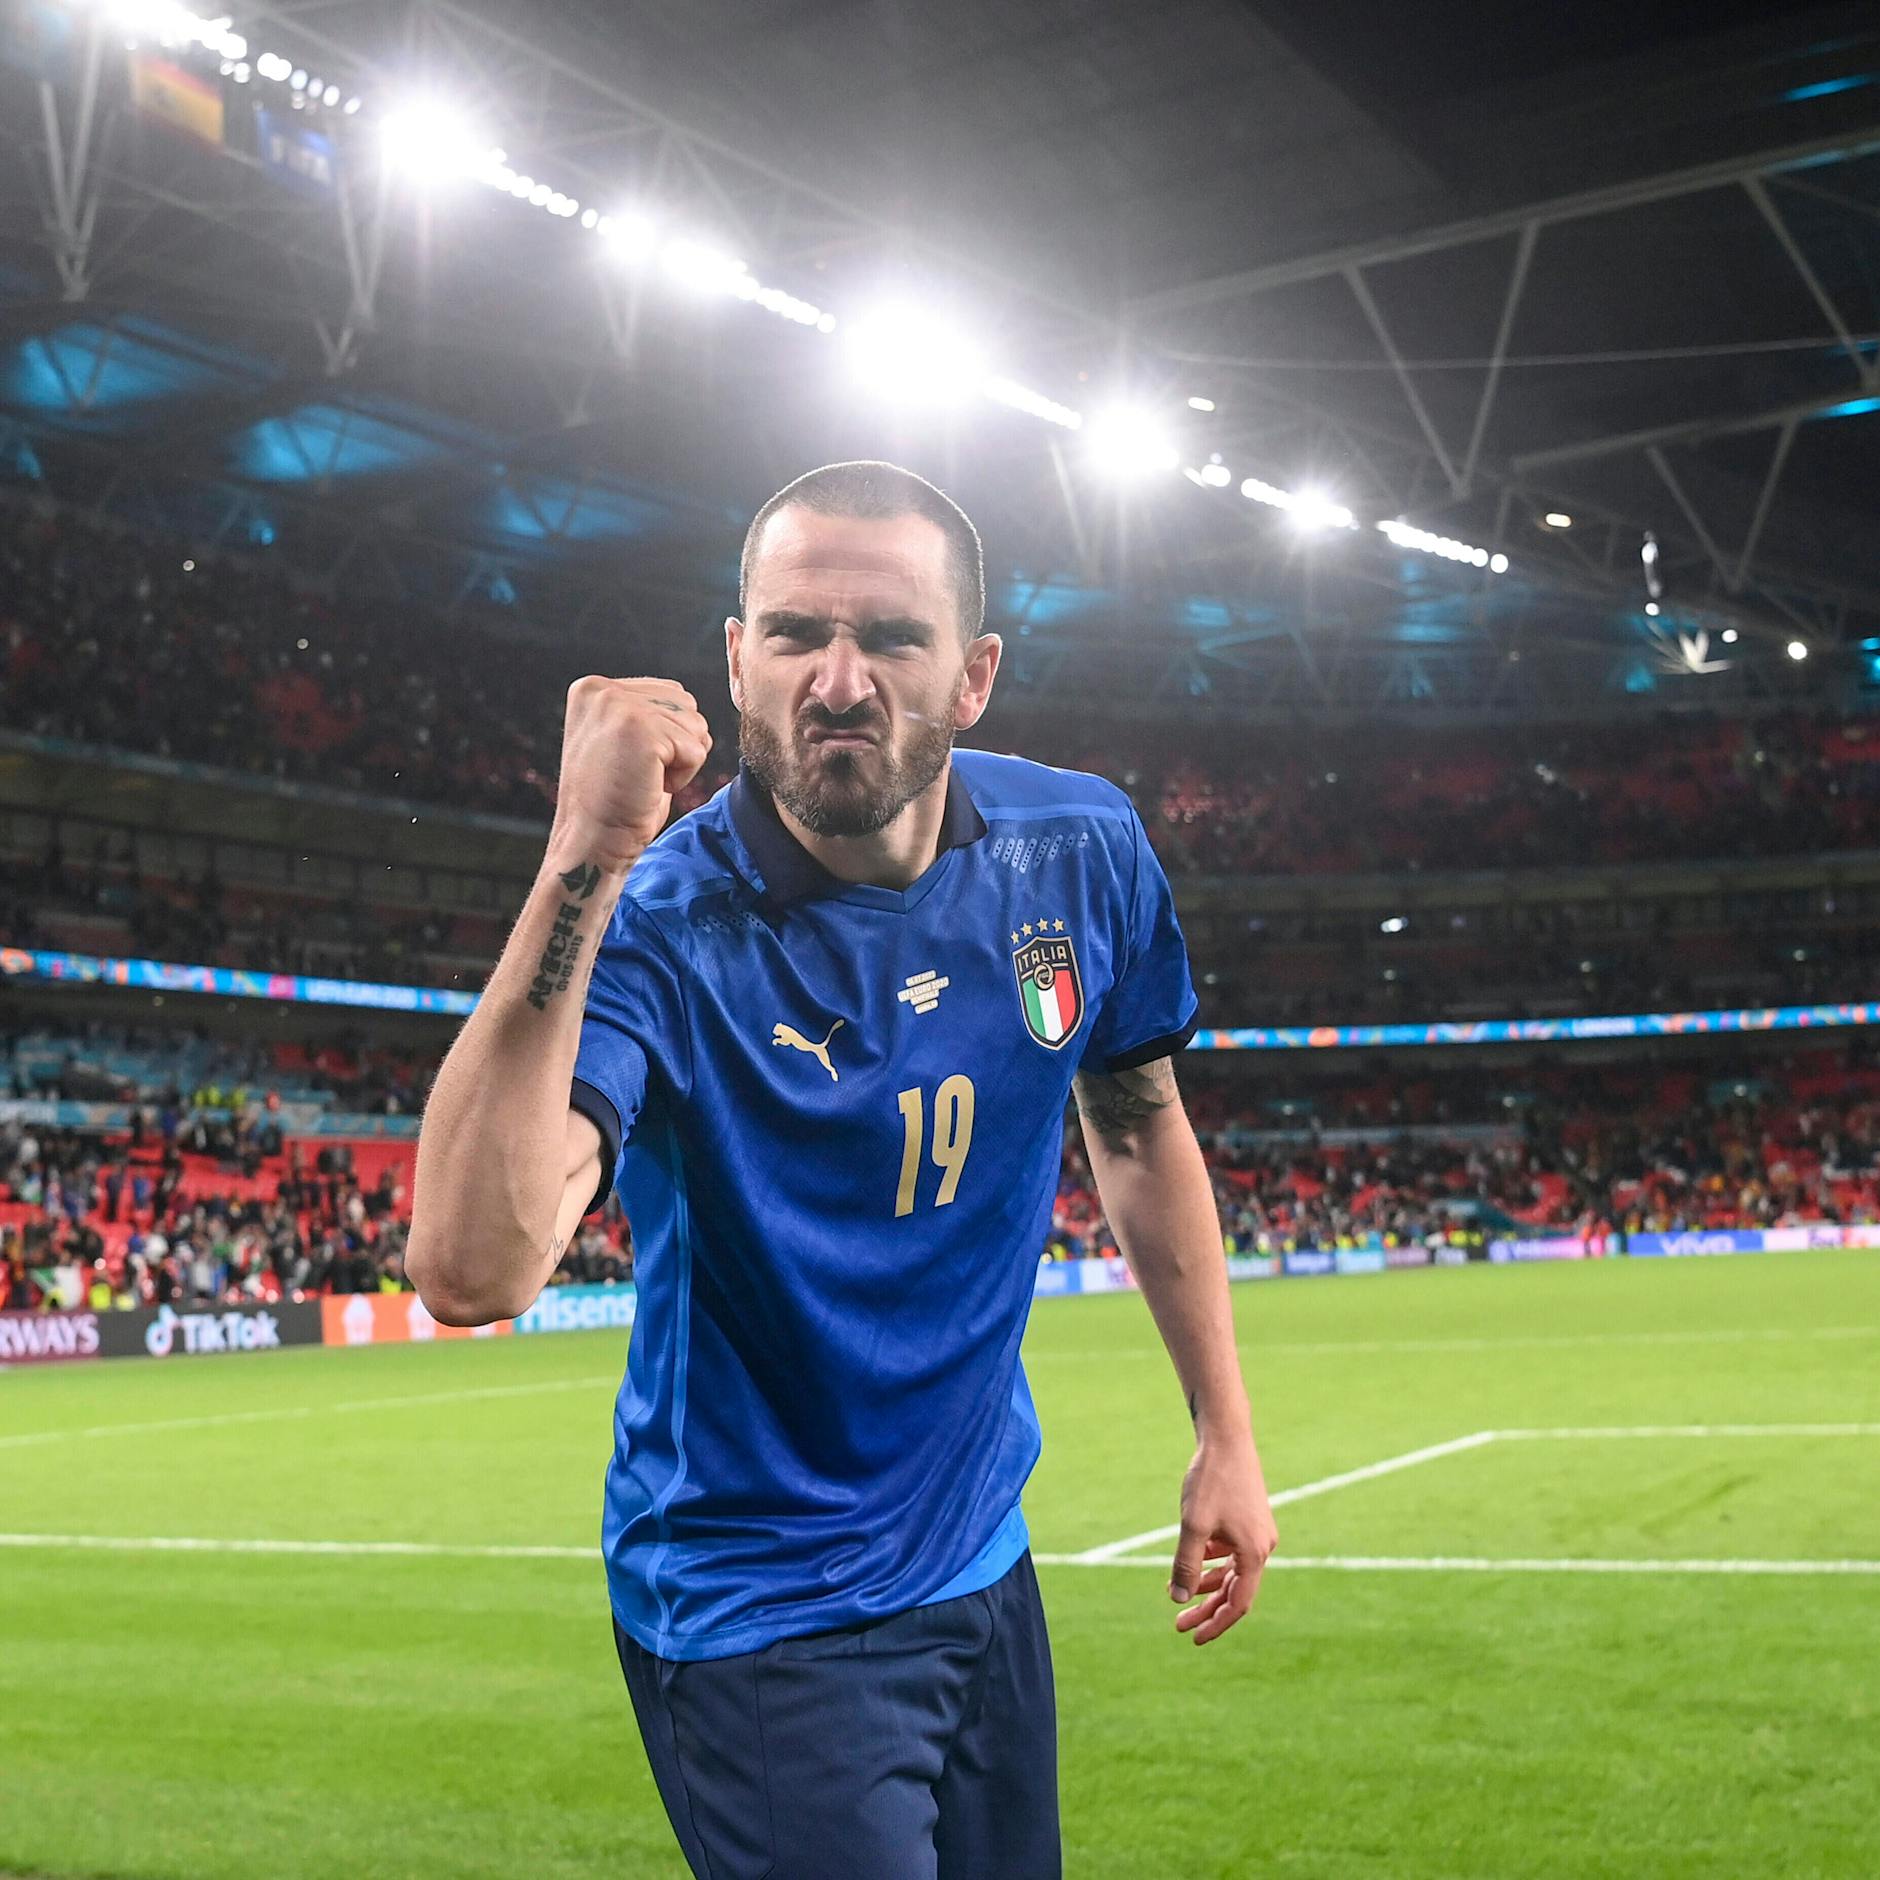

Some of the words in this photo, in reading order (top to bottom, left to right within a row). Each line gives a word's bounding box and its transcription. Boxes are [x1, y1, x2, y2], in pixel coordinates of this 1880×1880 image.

[1018, 945, 1068, 973] ITALIA
[895, 1074, 975, 1218] 19
[182, 1310, 281, 1354] TikTok
